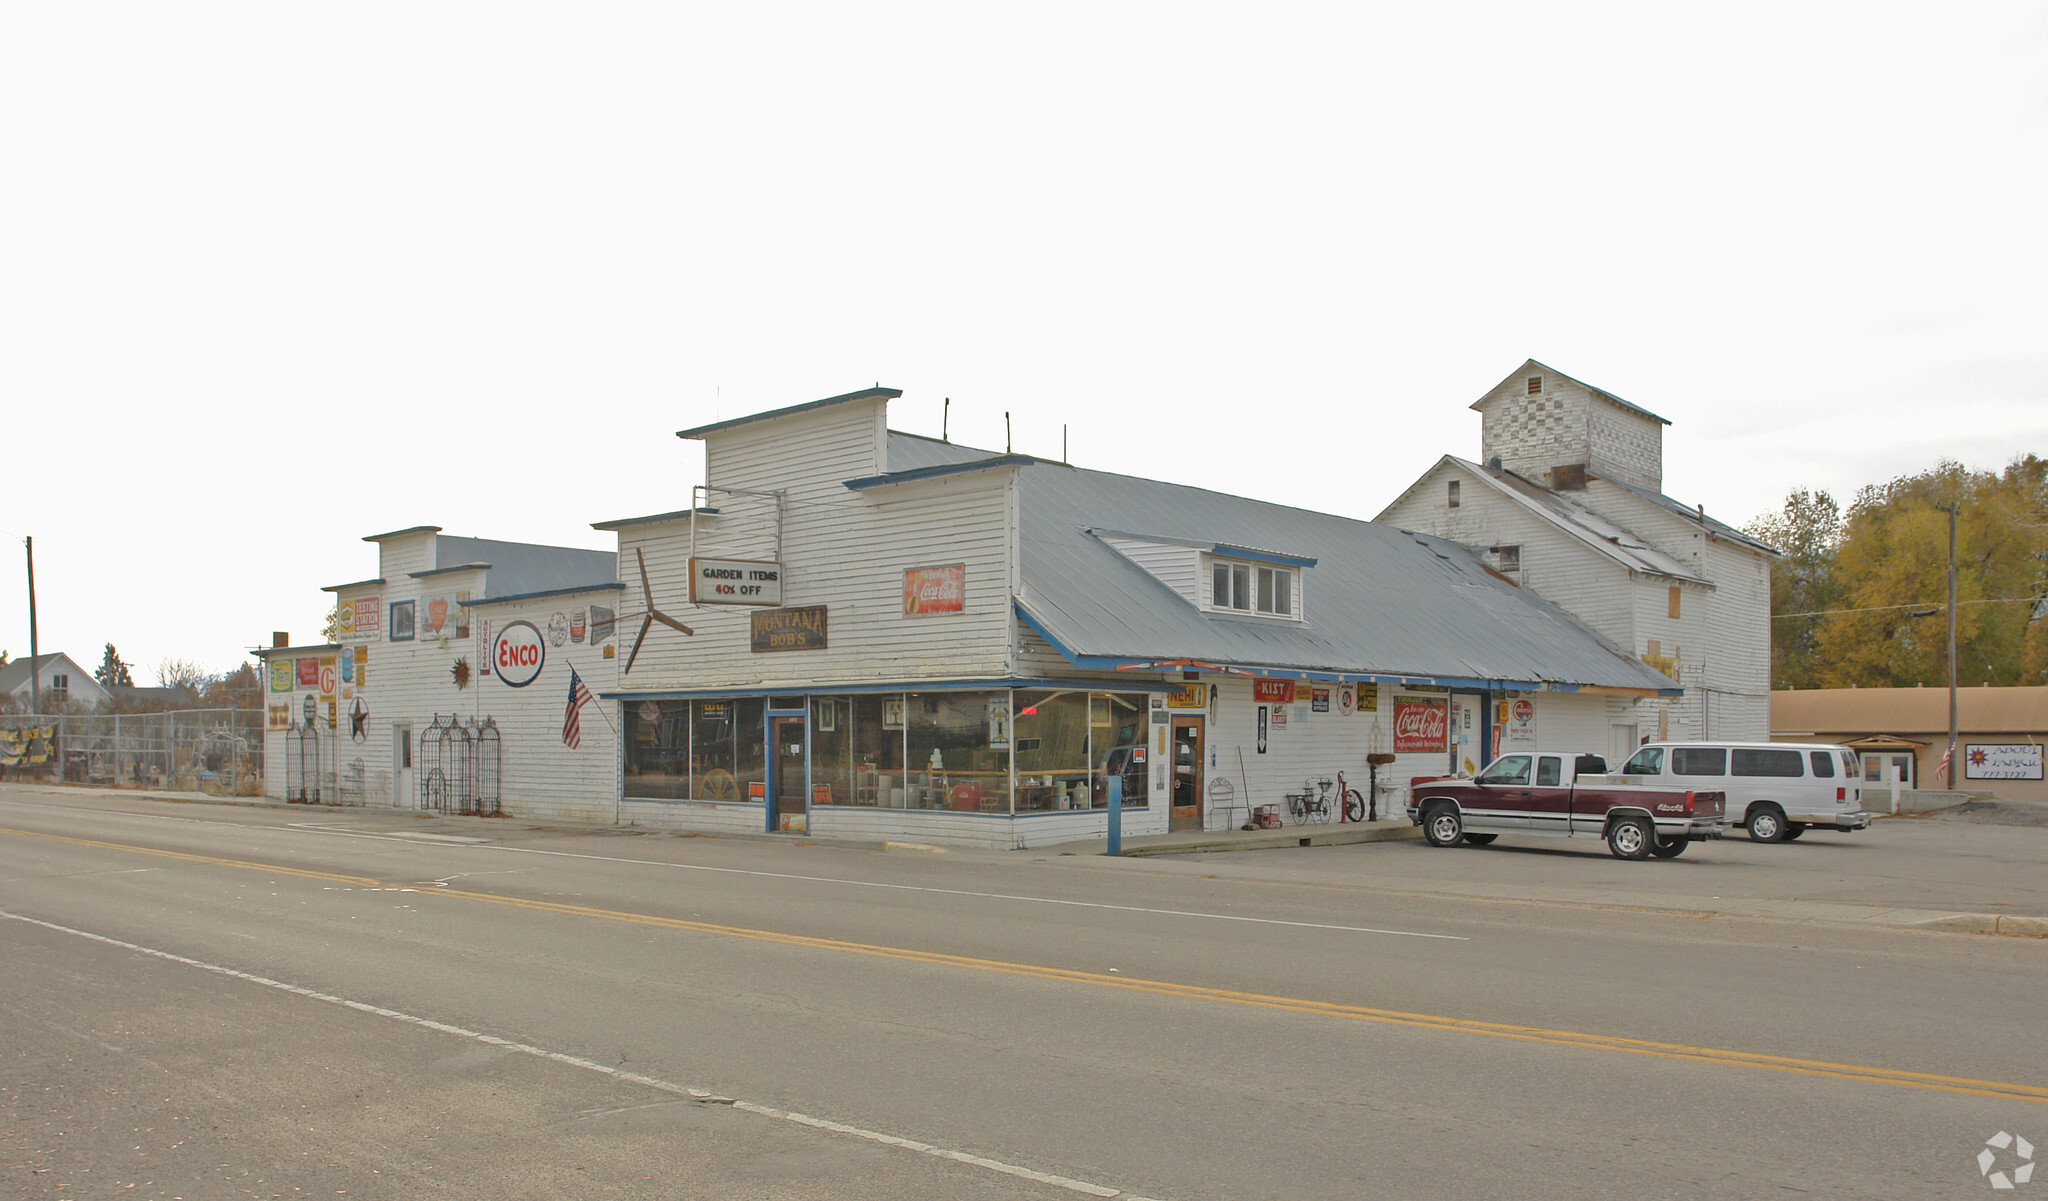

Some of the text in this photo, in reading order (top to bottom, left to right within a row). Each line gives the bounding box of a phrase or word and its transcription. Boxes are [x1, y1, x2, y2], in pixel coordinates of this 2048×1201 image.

[703, 568, 778, 581] GARDEN ITEMS
[715, 584, 762, 595] 40% OFF
[355, 600, 378, 613] TESTING
[355, 612, 378, 625] STATION
[753, 610, 823, 641] MONTANA
[769, 632, 806, 647] BOB'S
[498, 638, 538, 668] ENCO
[1170, 688, 1194, 702] NEHI
[1261, 682, 1285, 695] KIST
[1992, 746, 2038, 755] ABOUT
[1992, 759, 2041, 767] FABRIC
